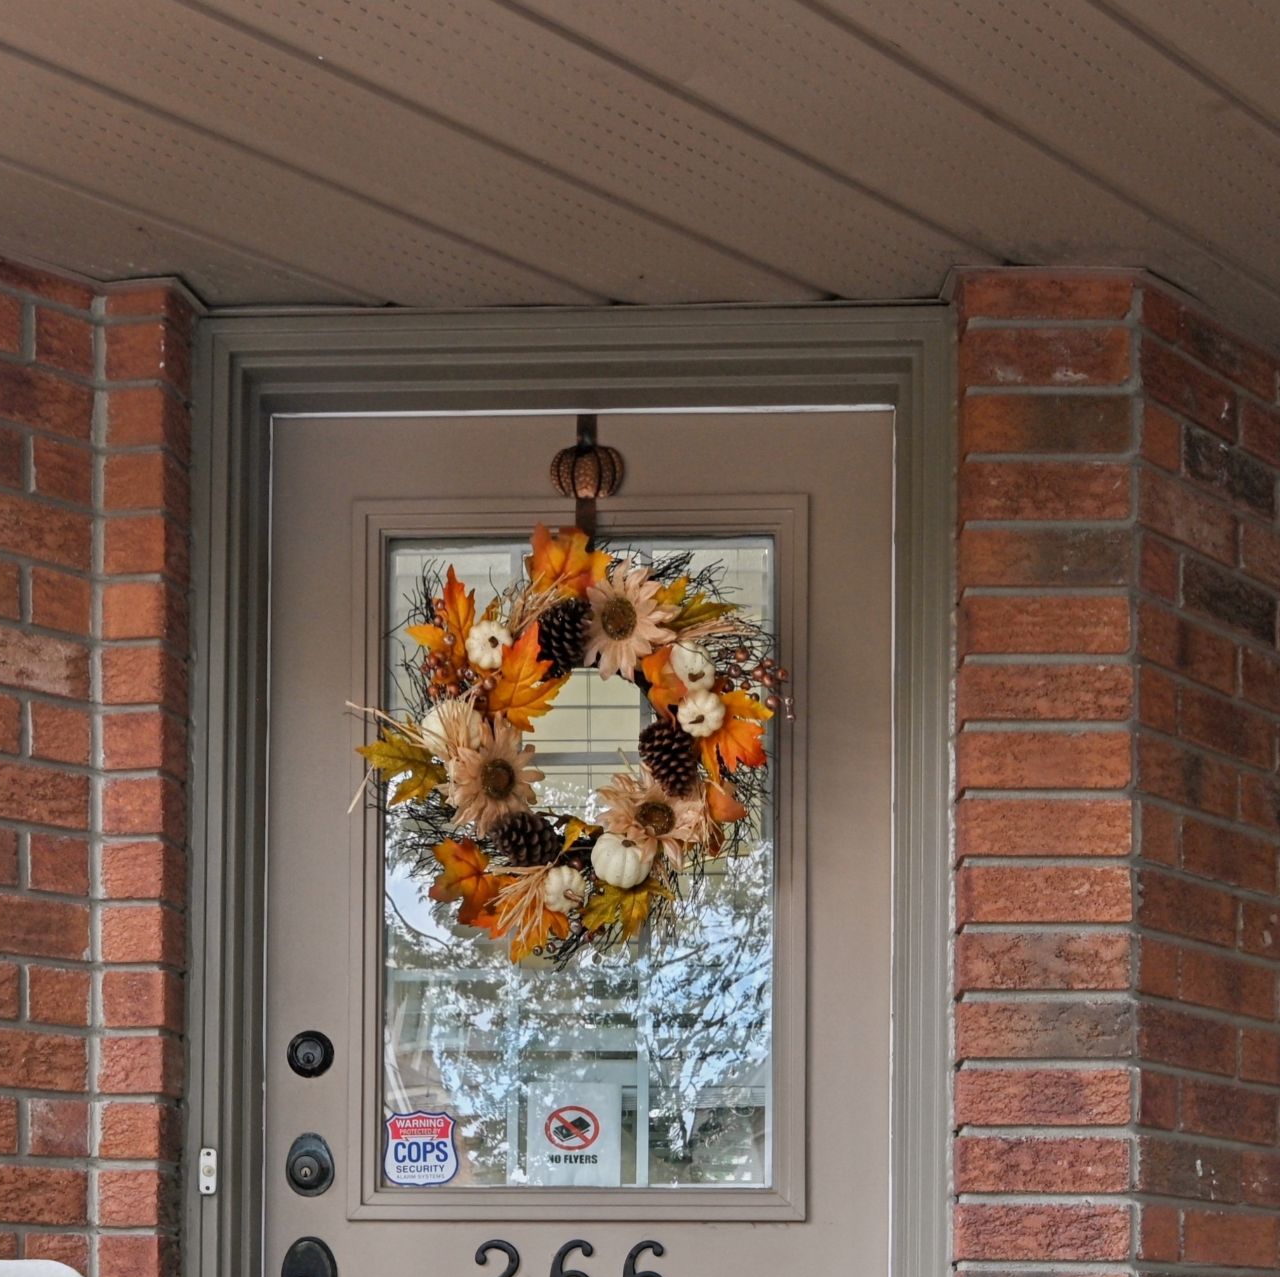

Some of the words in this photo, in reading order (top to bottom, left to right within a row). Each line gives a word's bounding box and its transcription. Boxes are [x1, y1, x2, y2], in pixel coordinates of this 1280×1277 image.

[396, 1118, 444, 1128] WARNING
[393, 1141, 448, 1163] COPS
[548, 1154, 562, 1164] NO
[563, 1154, 598, 1164] FLYERS
[396, 1164, 445, 1173] SECURITY
